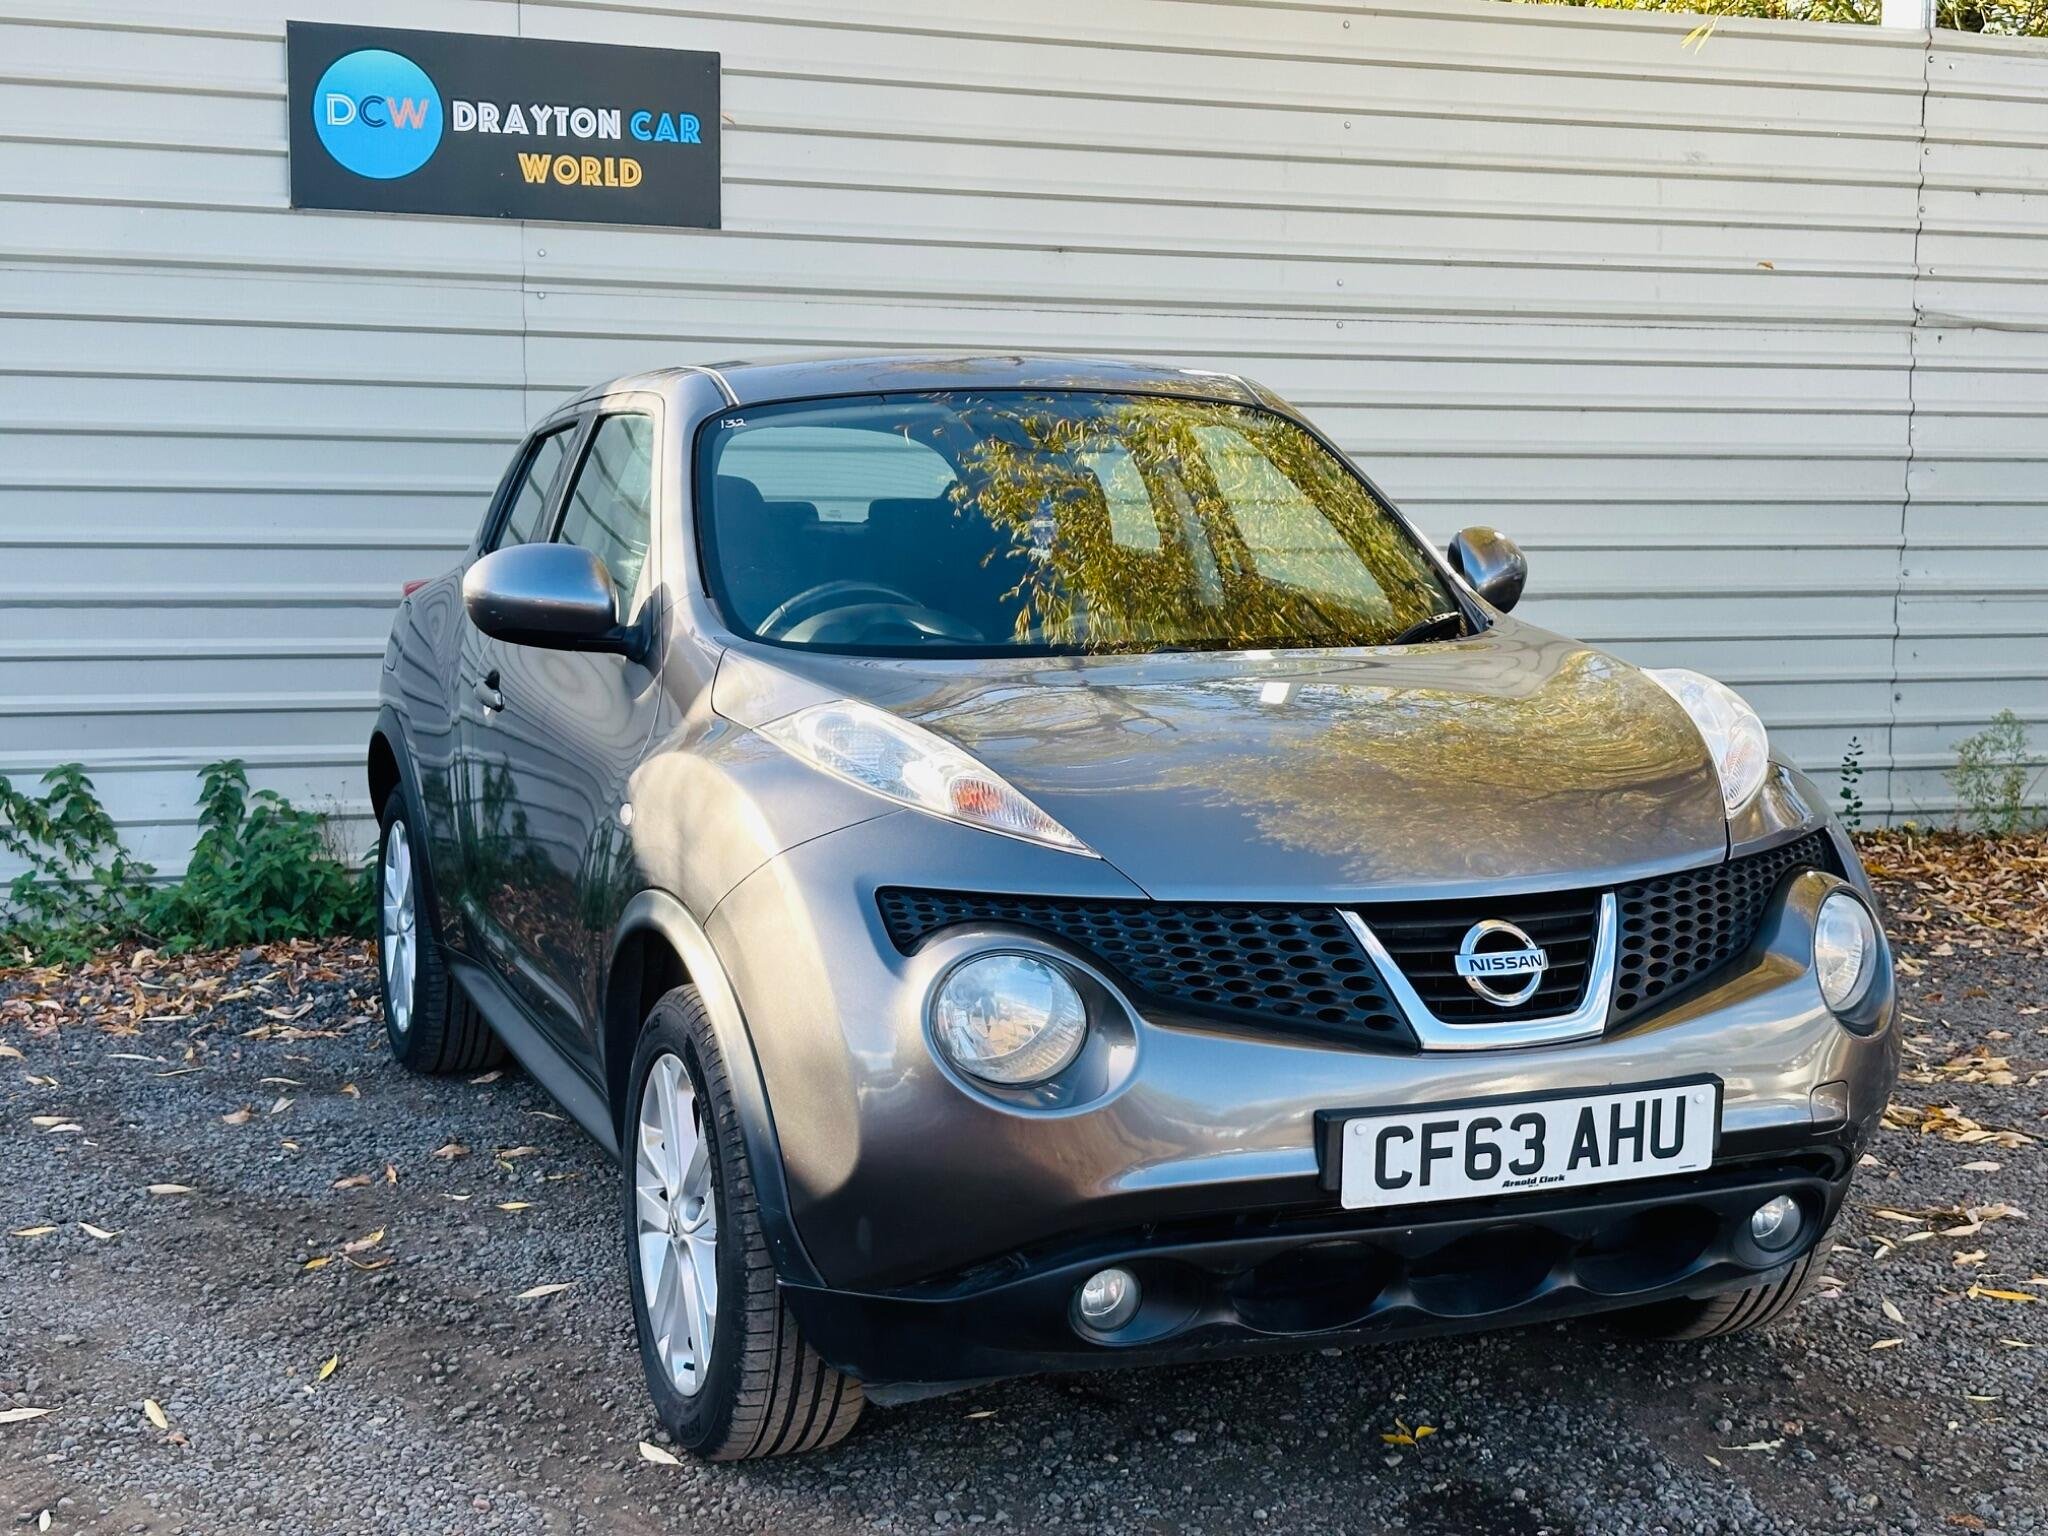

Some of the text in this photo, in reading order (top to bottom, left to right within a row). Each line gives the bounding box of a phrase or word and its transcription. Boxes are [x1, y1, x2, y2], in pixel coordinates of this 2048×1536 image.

[326, 93, 428, 129] DCW
[453, 100, 701, 144] DRAYTON CAR
[518, 152, 643, 188] WORLD
[721, 418, 746, 429] 132
[1468, 955, 1542, 971] NISSAN
[1374, 1095, 1686, 1190] CF63 AHU
[1502, 1177, 1537, 1187] Arnold
